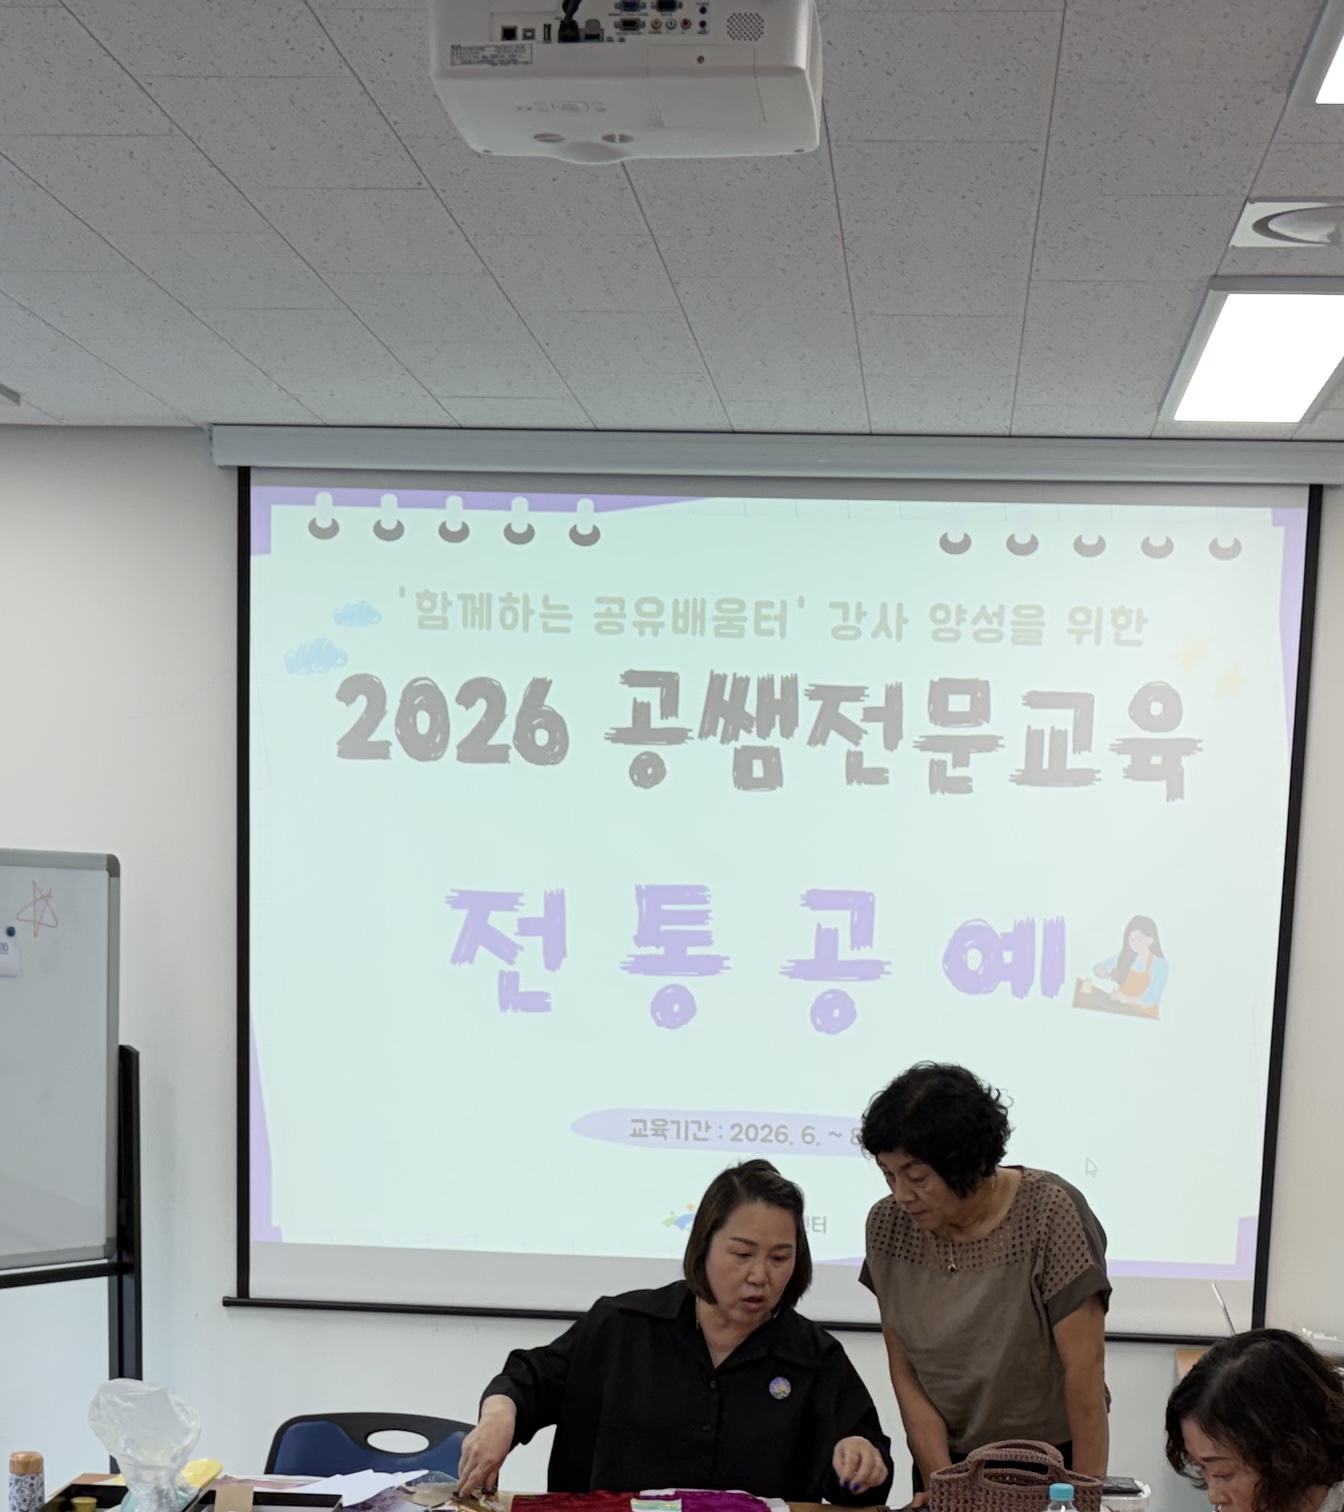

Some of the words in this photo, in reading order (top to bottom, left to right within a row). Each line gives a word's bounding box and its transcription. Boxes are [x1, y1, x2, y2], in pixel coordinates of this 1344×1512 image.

[828, 600, 909, 643] 강사
[929, 603, 1046, 646] 양성을
[1066, 606, 1149, 647] 위한
[335, 673, 570, 766] 2026
[603, 669, 1204, 802] 공쌤전문교육
[629, 1117, 711, 1142] 교육기간
[729, 1122, 794, 1146] 2026.
[801, 1125, 821, 1147] 6.
